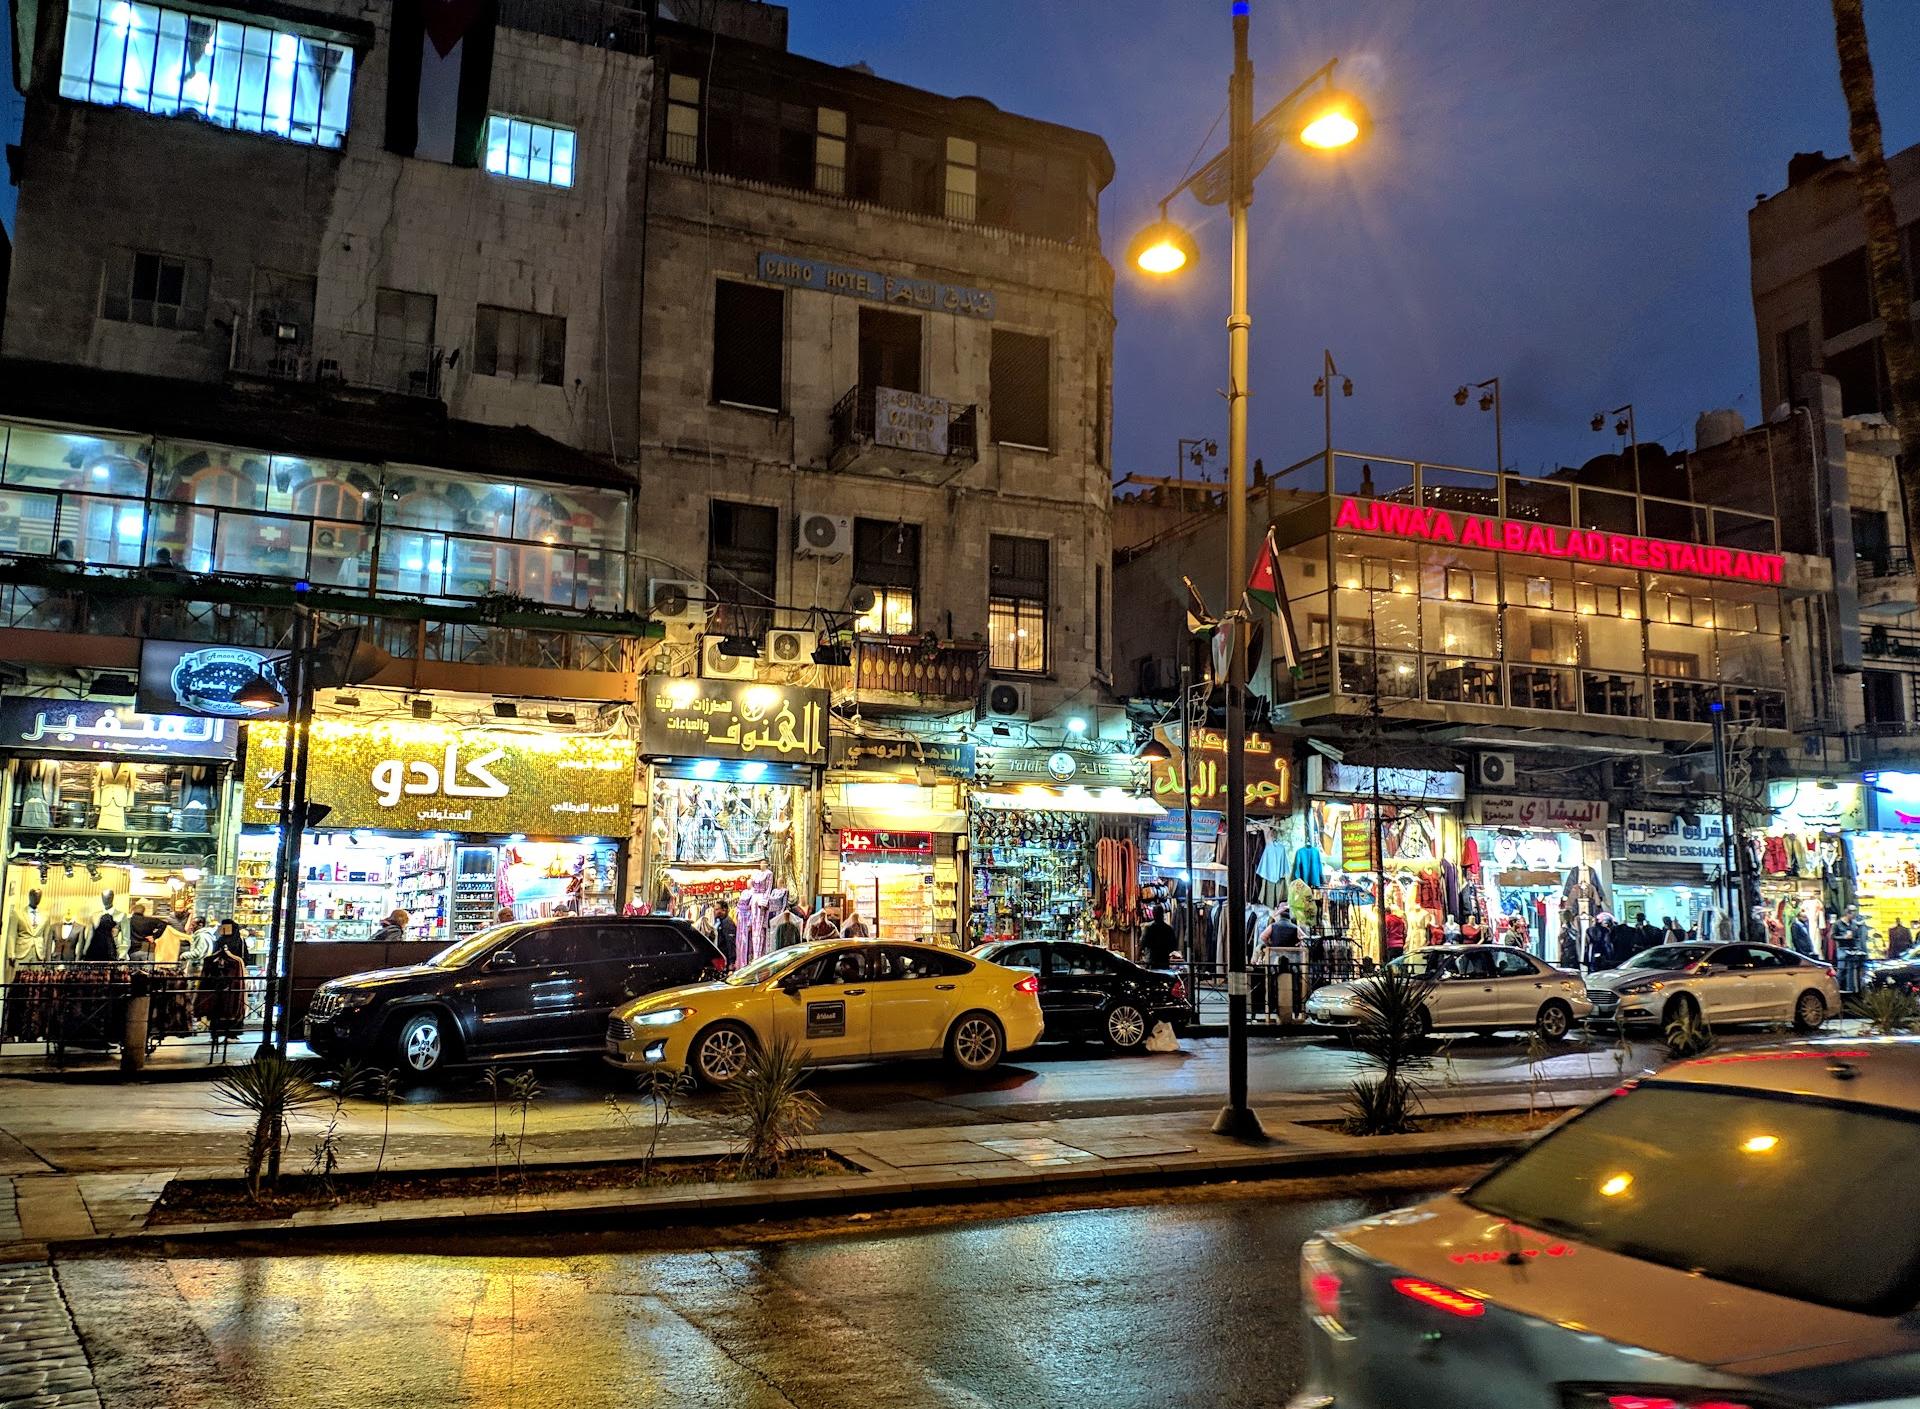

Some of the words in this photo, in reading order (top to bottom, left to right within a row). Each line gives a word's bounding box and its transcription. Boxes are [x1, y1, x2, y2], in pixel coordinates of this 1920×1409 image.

[765, 259, 812, 281] CAIRO
[827, 270, 875, 293] HOTEL
[943, 286, 992, 313] فندق
[1335, 498, 1457, 543] AJWA'A
[1461, 514, 1606, 561] ALBALAD
[1608, 534, 1785, 584] RESTAURANT
[237, 653, 252, 662] Cafe
[190, 677, 226, 691] عمون
[20, 708, 224, 742] السفير
[706, 700, 825, 754] الهنوف
[848, 744, 906, 761] الروسي
[371, 745, 510, 807] كادو
[1154, 759, 1218, 807] البلد
[841, 831, 871, 849] جهاز
